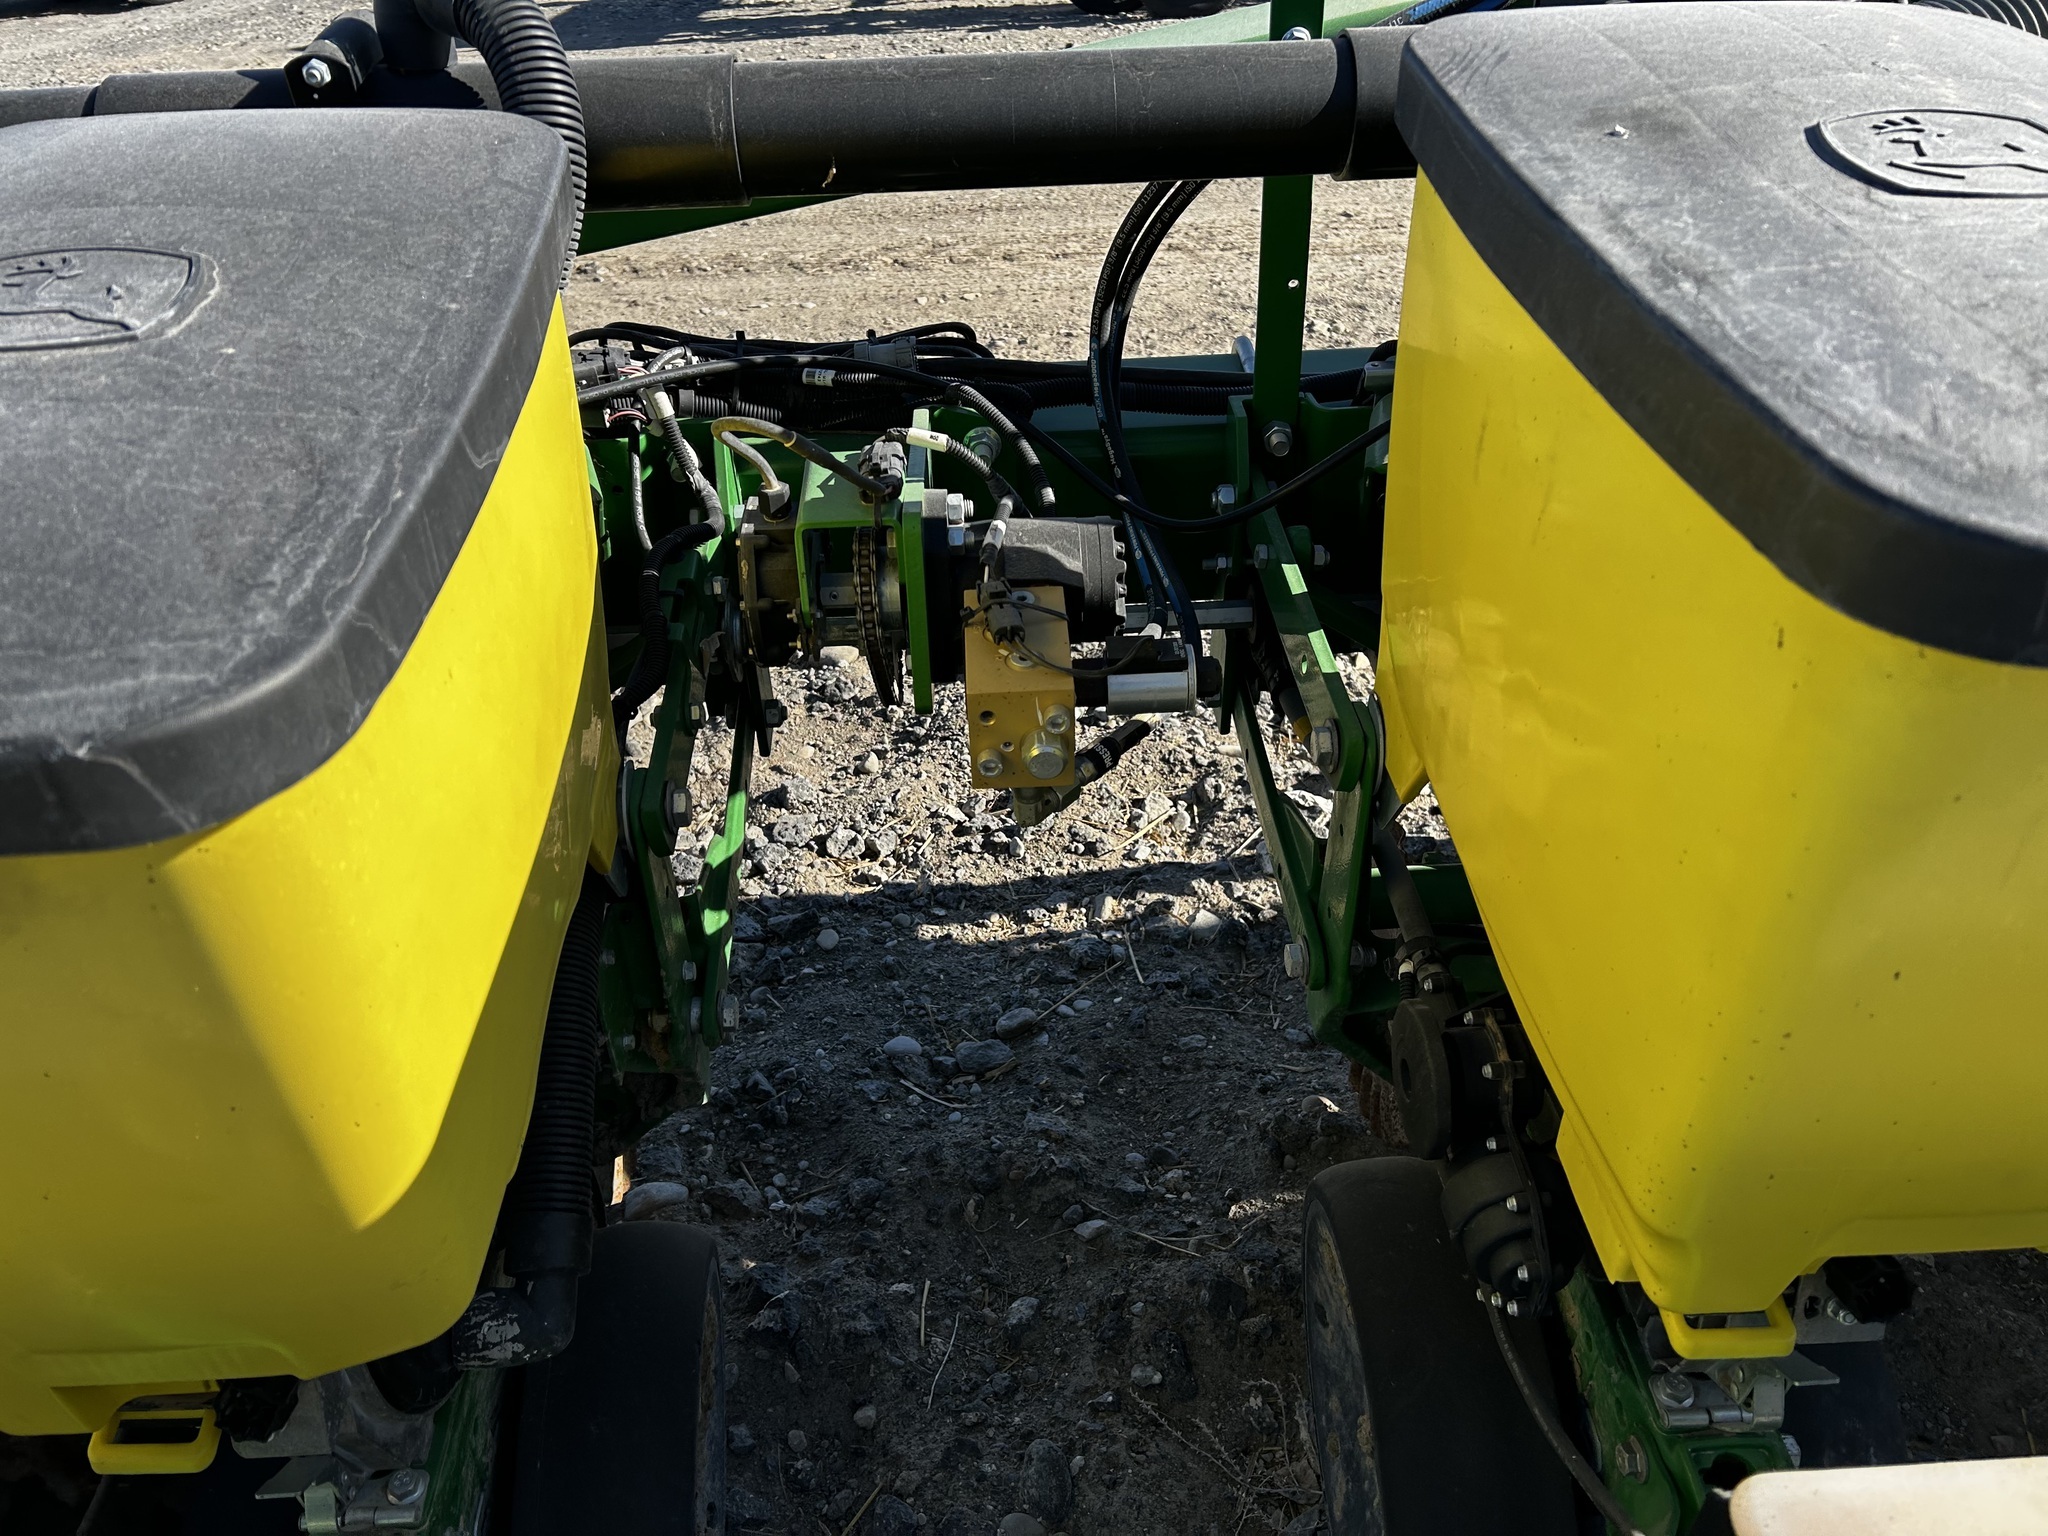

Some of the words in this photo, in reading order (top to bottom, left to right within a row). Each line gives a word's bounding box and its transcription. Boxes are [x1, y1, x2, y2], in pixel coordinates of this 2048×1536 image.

[1185, 181, 1197, 194] ISO
[1094, 302, 1102, 318] MPa
[1133, 203, 1144, 217] ISO
[1143, 181, 1160, 205] 11237
